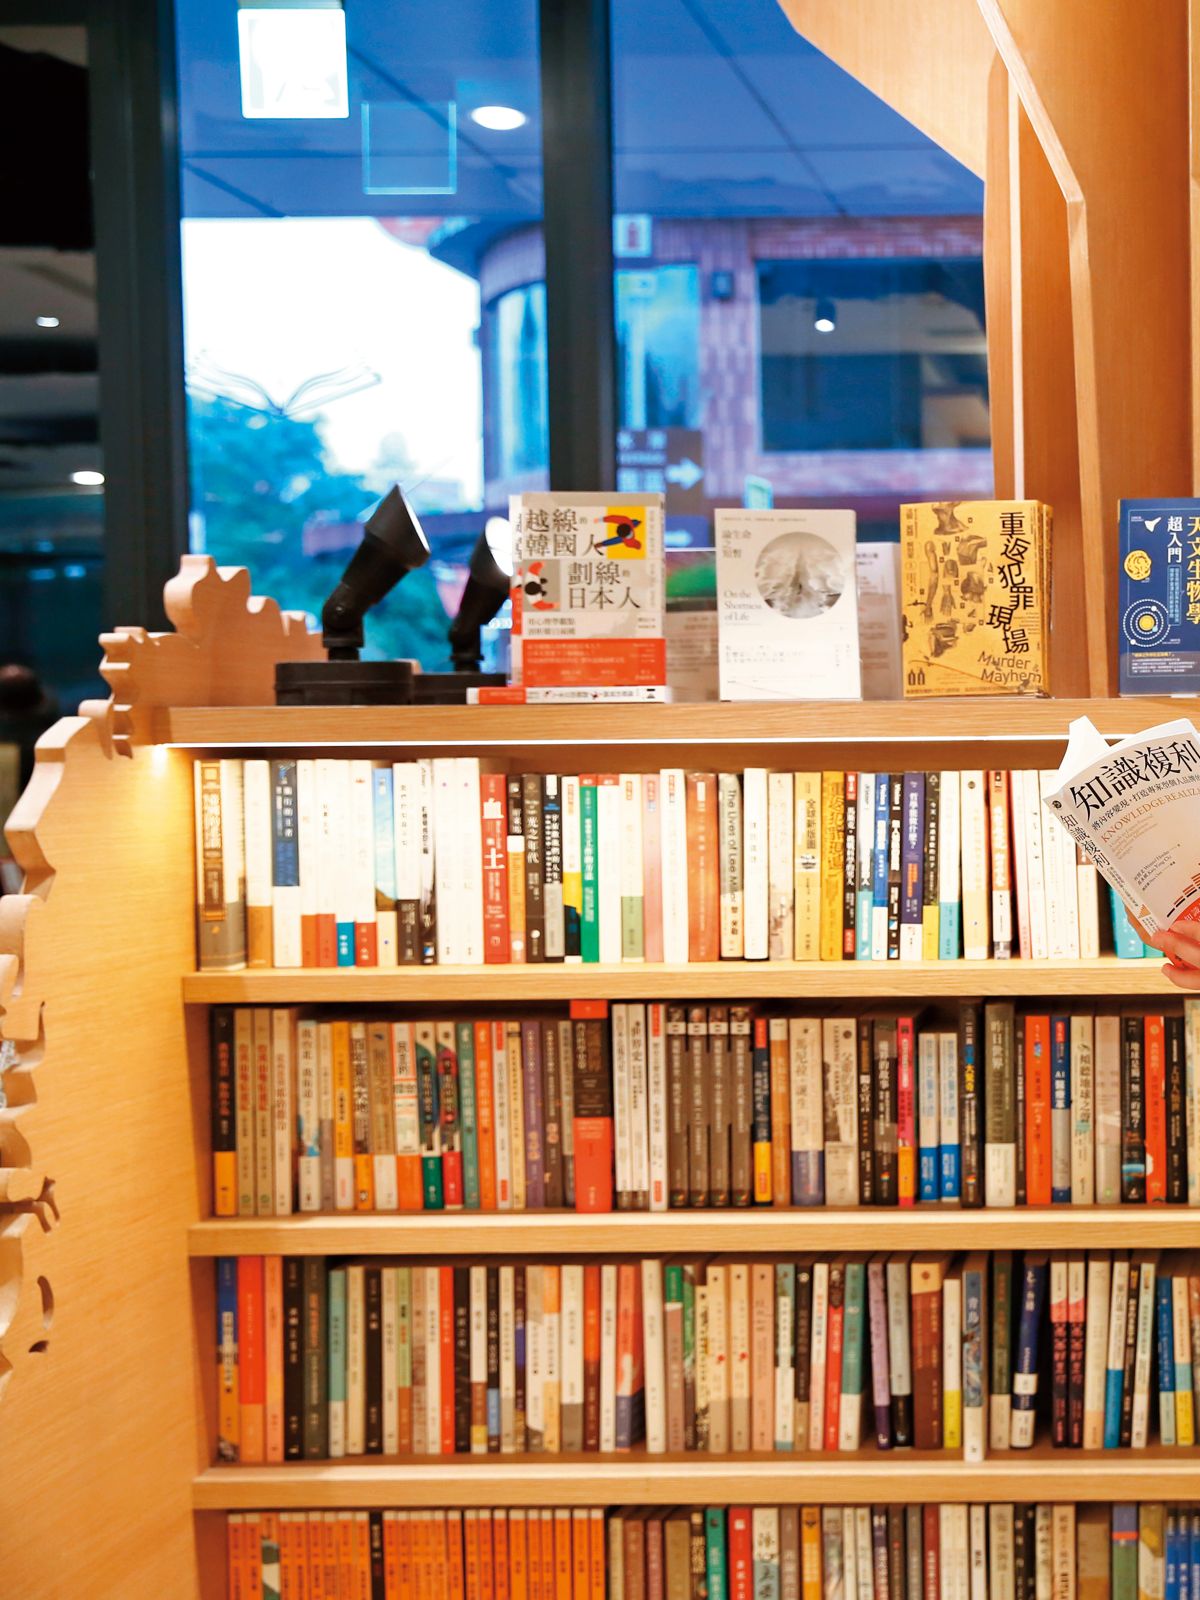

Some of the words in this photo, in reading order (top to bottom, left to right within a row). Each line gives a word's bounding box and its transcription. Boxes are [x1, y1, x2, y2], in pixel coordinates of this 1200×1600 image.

[526, 533, 605, 558] 韓國人
[1167, 516, 1183, 563] 超入門
[569, 586, 641, 610] 日本人
[986, 511, 1034, 654] 重返犯罪現場
[978, 651, 1031, 671] Murder
[981, 668, 1042, 686] Mayhem
[1101, 799, 1167, 843] KNOWLEDGE
[1061, 814, 1111, 868] 知識複利
